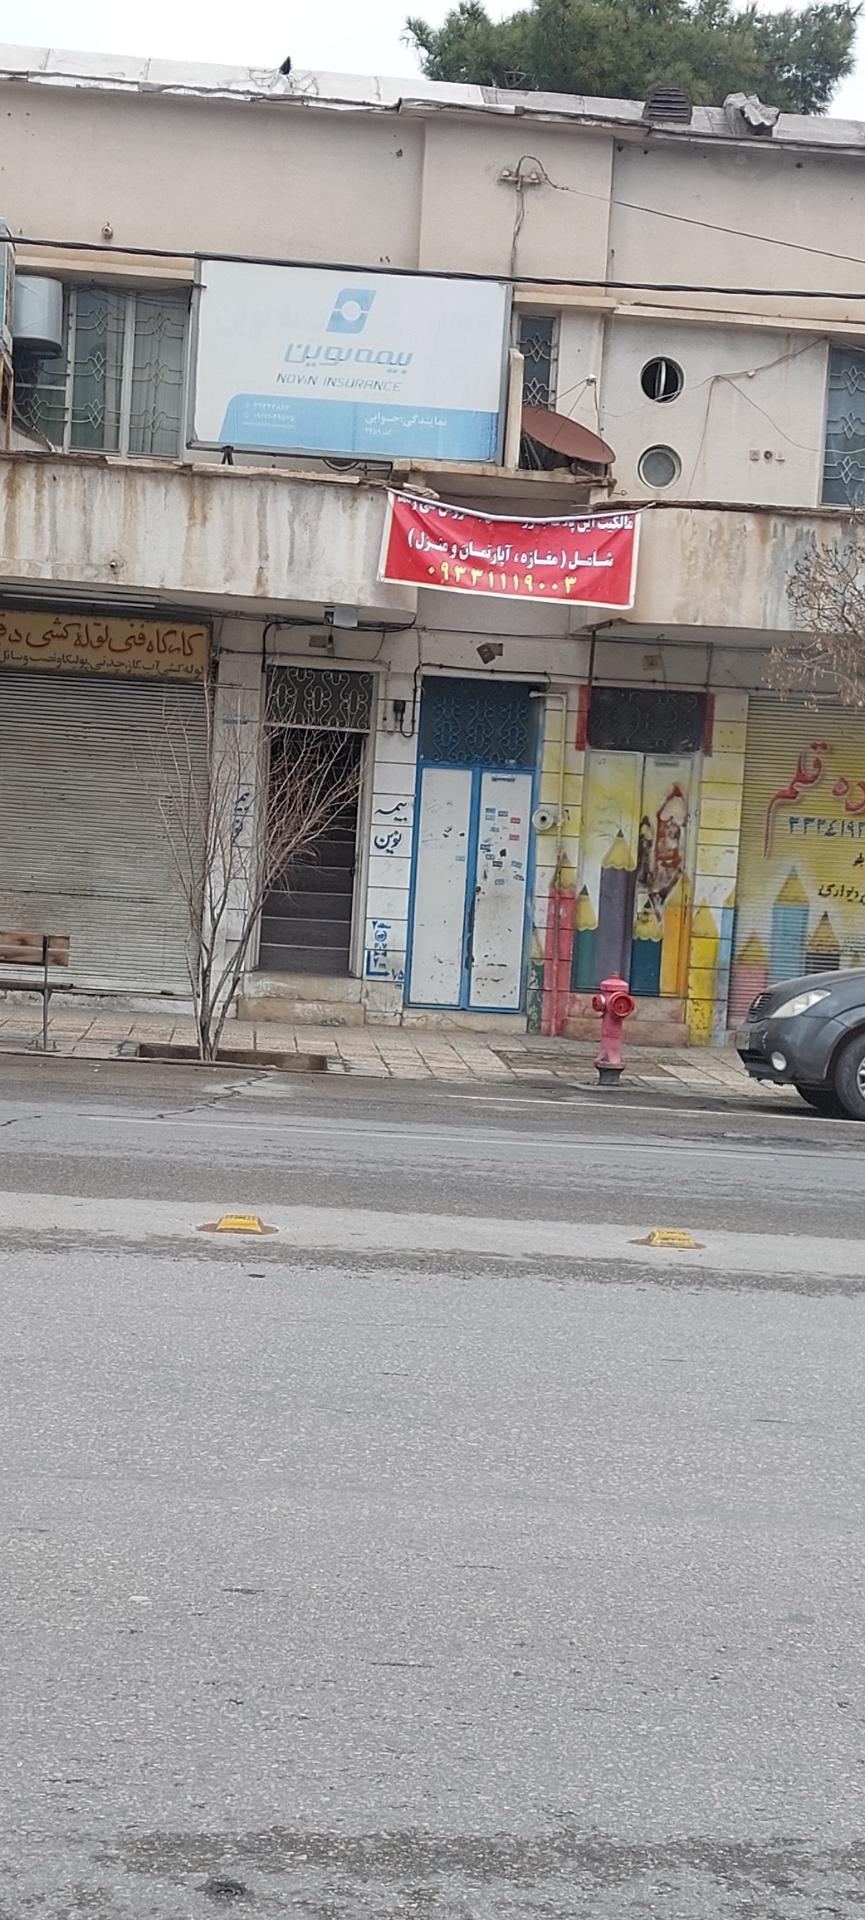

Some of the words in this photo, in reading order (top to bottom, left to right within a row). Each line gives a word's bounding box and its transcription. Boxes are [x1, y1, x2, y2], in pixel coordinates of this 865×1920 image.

[284, 343, 353, 367] نوین
[354, 348, 414, 375] بیمه
[322, 377, 403, 392] INSURANCE
[449, 544, 457, 559] و
[458, 542, 512, 567] آپارتمان
[568, 552, 614, 571] شامل
[427, 561, 577, 594] ۰۹۳۳۱۱۱۹۰۰۳
[26, 617, 82, 648] کشی
[72, 622, 110, 649] لوله
[107, 622, 147, 652] فنی
[146, 629, 204, 656] کارگاه
[142, 660, 159, 675] آب
[158, 661, 184, 676] کشی
[374, 801, 408, 822] بیمه
[763, 739, 830, 860] قلم
[373, 829, 403, 854] نوین
